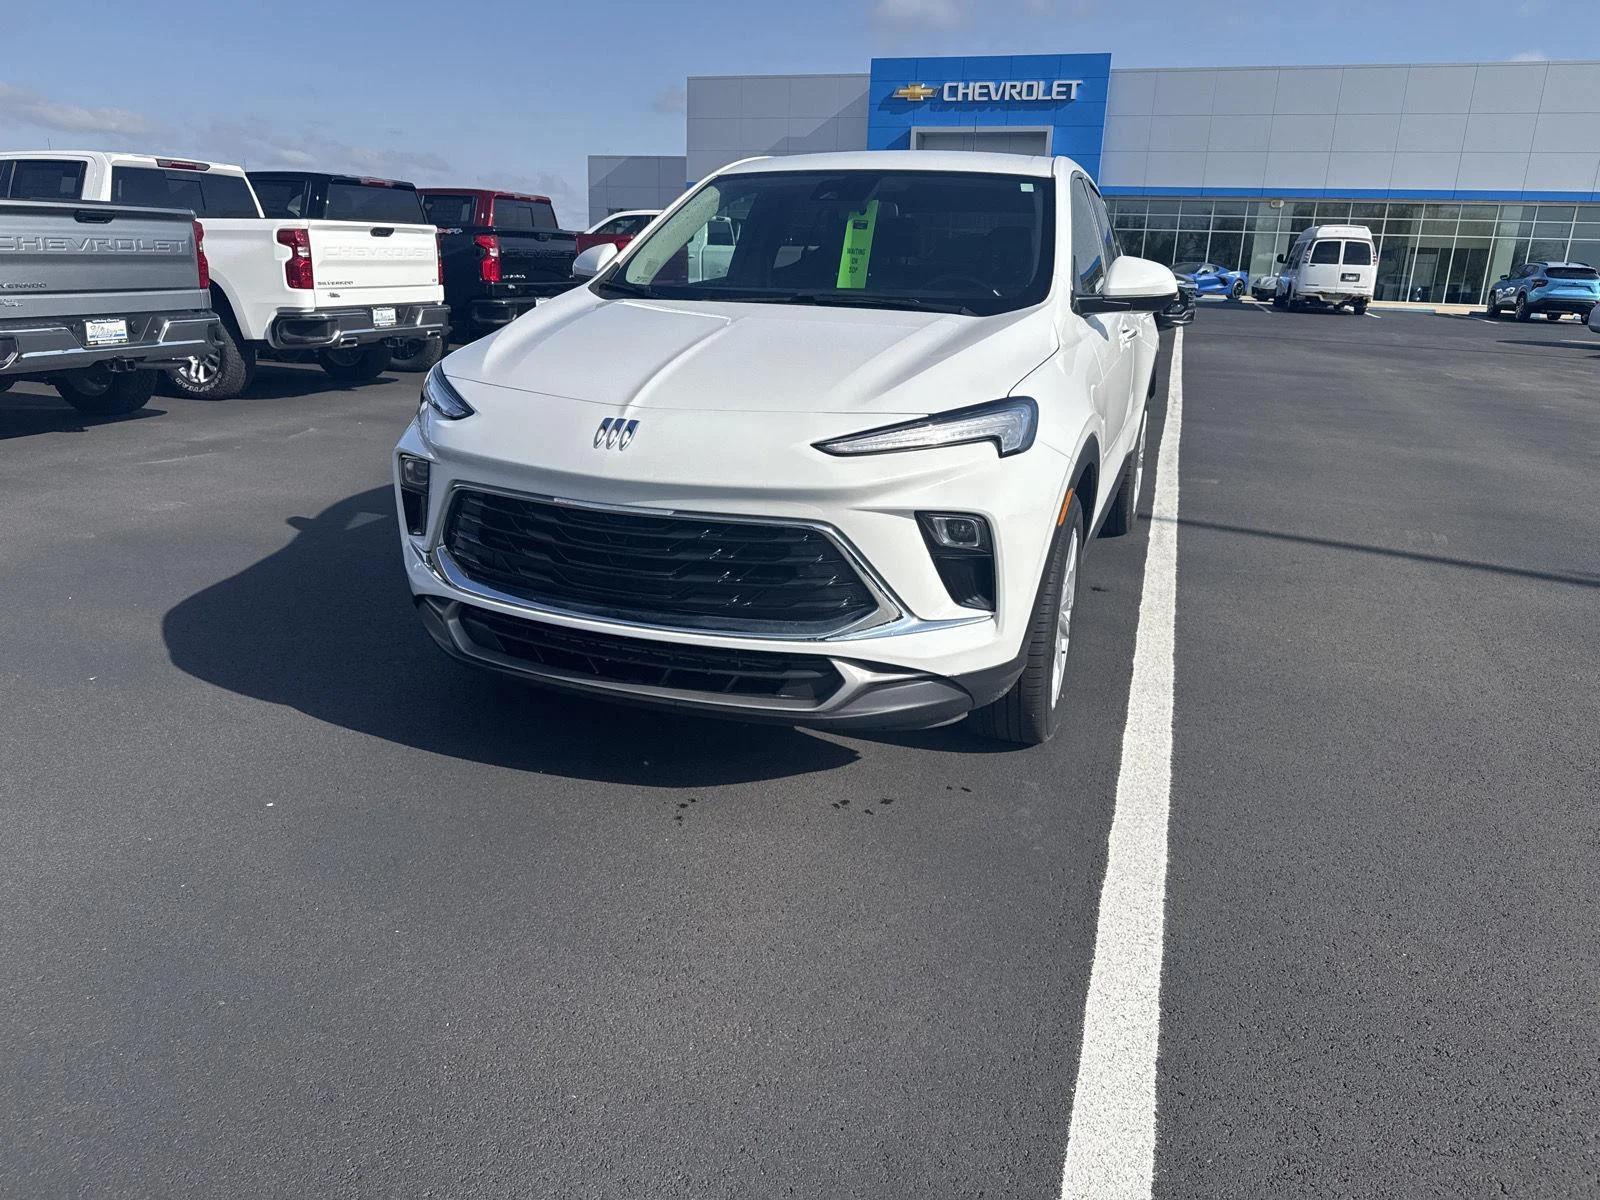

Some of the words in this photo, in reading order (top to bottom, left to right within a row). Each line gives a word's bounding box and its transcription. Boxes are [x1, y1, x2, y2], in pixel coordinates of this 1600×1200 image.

[943, 80, 1083, 101] CHEVROLET
[323, 247, 435, 257] CHEVROLET
[847, 247, 866, 255] WAITING
